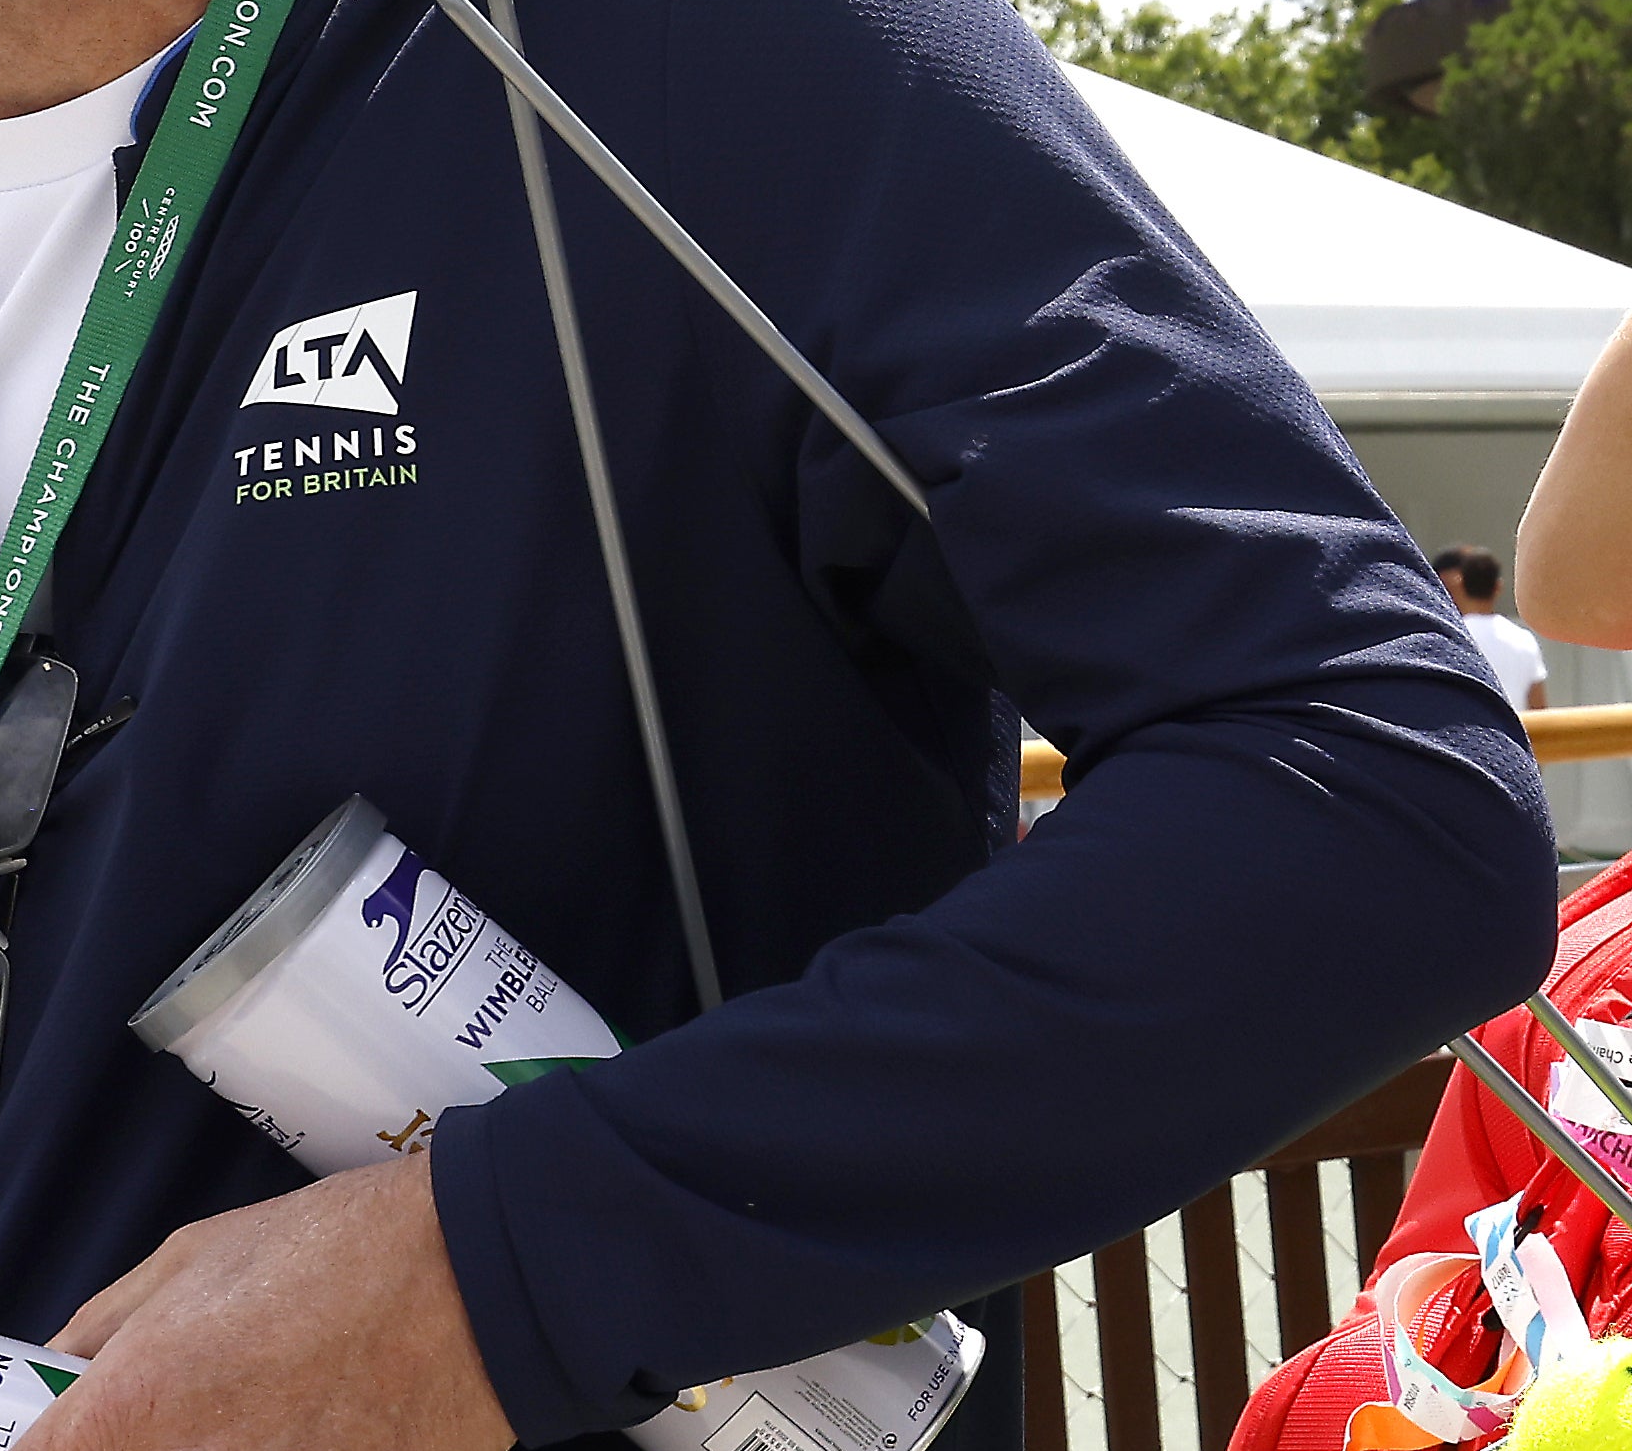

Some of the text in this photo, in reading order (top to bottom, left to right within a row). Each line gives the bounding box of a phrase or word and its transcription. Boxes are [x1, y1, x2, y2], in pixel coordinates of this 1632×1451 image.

[124, 187, 175, 299] CENTRE COURT
[68, 362, 111, 426] THE
[233, 425, 418, 477] TENNIS
[235, 464, 418, 505] FOR BRITAIN
[381, 891, 487, 1011] Slazen
[484, 936, 516, 970] THE
[524, 977, 560, 1015] BALL
[907, 1390, 934, 1422] FOR
[928, 1363, 951, 1392] USE
